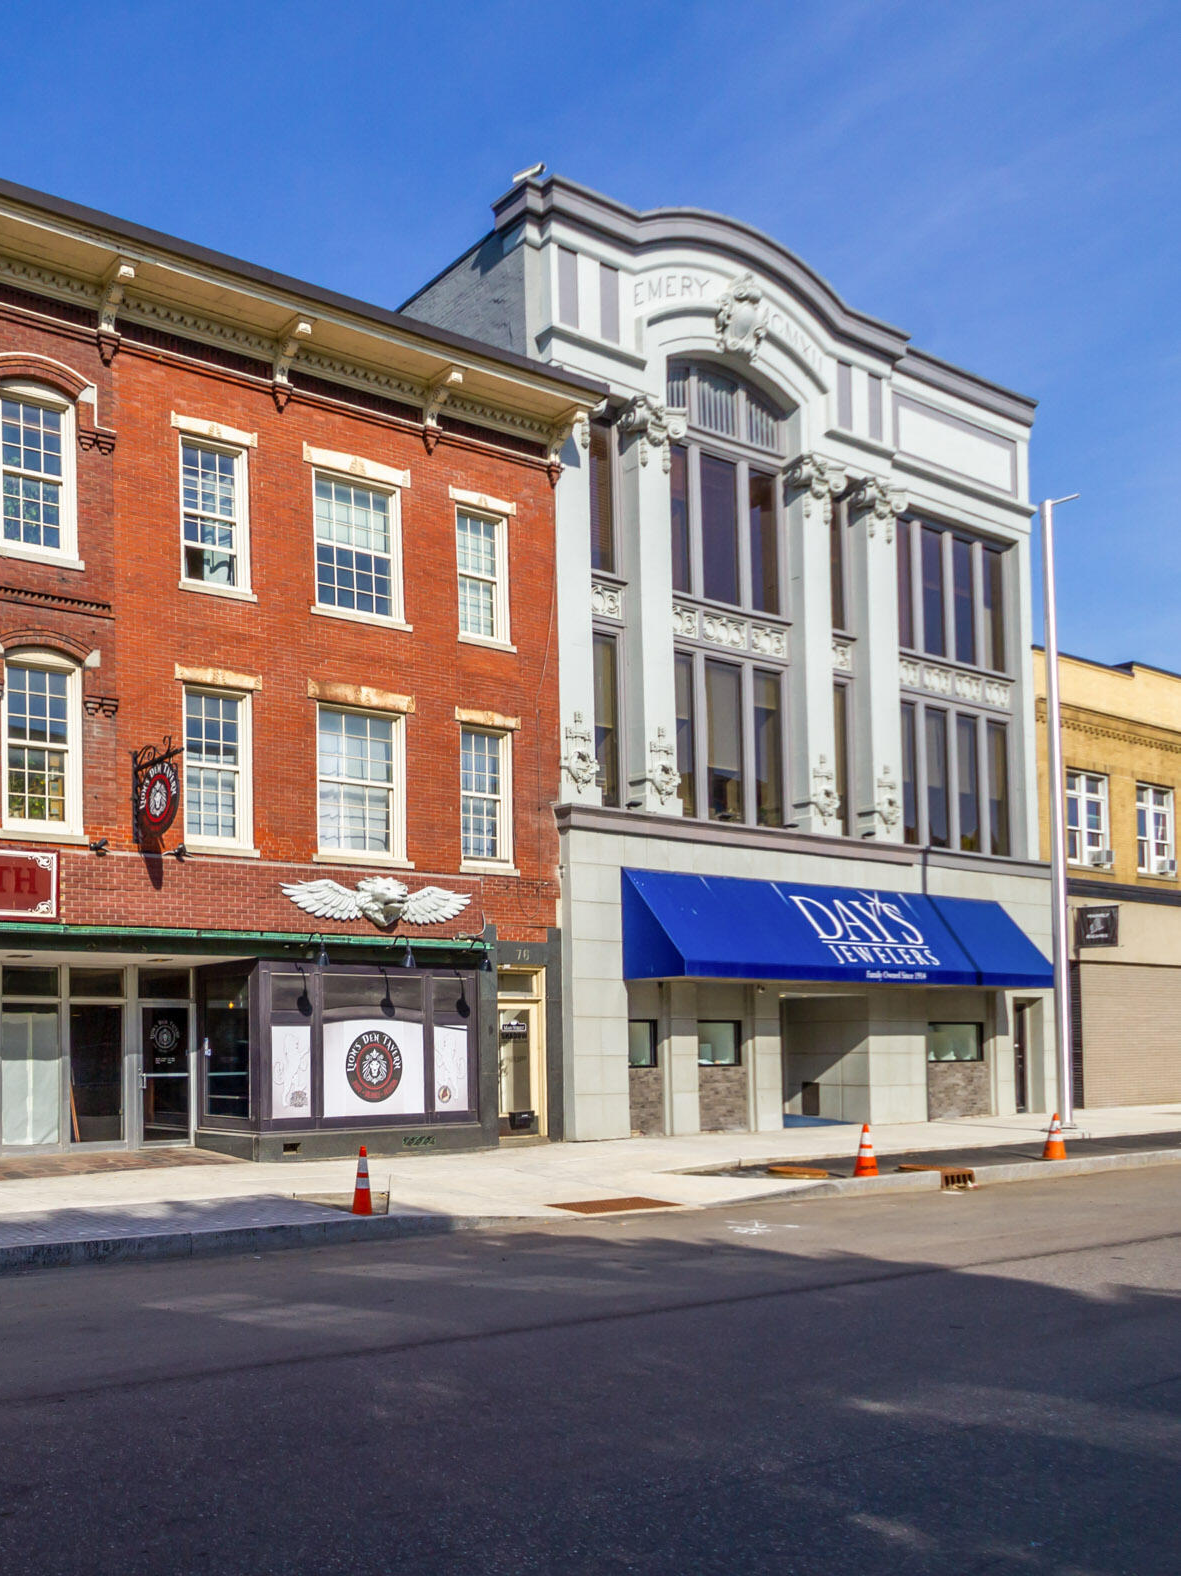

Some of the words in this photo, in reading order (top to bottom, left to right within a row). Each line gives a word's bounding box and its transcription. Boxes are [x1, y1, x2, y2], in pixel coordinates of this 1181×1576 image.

[633, 275, 710, 307] EMERY
[788, 895, 924, 945] DAY'S
[828, 945, 941, 966] JEWELERS
[346, 1042, 362, 1072] LION'S
[362, 1032, 380, 1044] DEN
[382, 1034, 401, 1070] TAVERN
